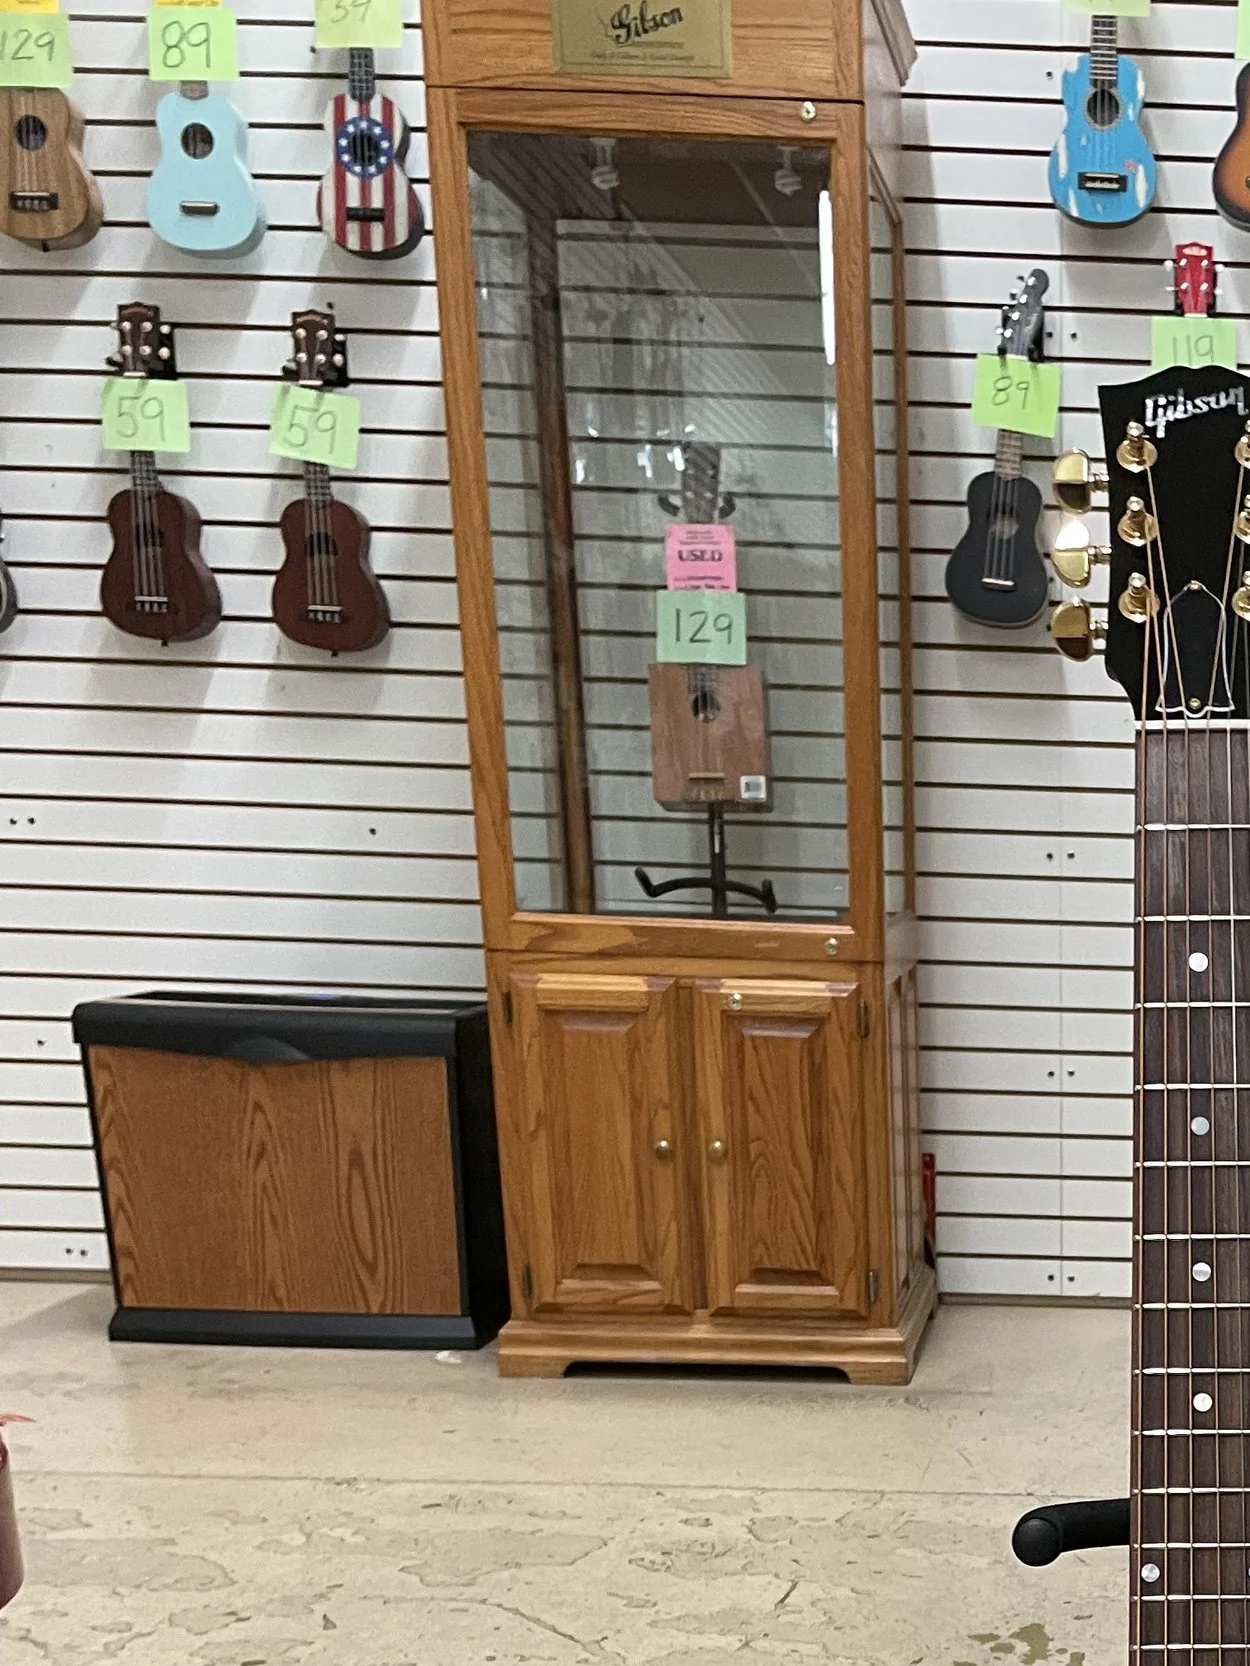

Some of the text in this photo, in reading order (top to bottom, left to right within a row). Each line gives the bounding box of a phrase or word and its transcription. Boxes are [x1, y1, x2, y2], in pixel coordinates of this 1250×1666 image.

[610, 0, 683, 44] Gibson
[0, 29, 55, 61] 129
[162, 21, 211, 68] 89
[1172, 335, 1215, 364] 119
[991, 376, 1031, 409] 89
[1145, 386, 1249, 438] Gibson
[117, 396, 165, 443] 59
[283, 405, 338, 454] 59
[678, 550, 723, 562] USED
[675, 608, 734, 644] 129
